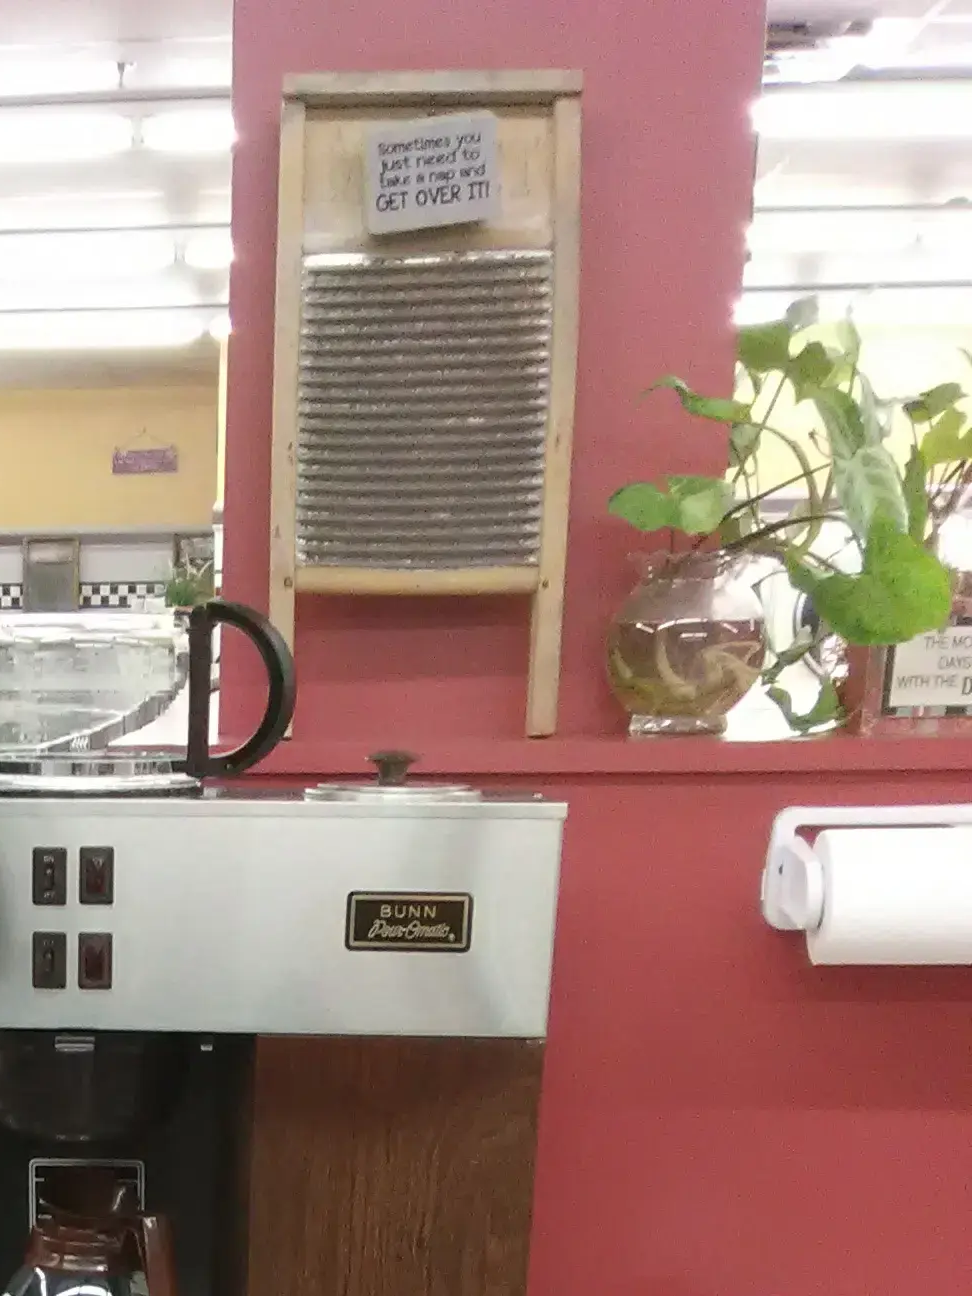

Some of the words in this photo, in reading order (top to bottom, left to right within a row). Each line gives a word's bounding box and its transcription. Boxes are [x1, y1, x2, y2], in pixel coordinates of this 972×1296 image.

[456, 132, 482, 152] you
[416, 150, 457, 168] need
[462, 148, 480, 161] to
[428, 169, 455, 185] nap
[375, 191, 408, 213] GET
[415, 184, 461, 206] OVER
[924, 635, 949, 651] THE
[896, 675, 929, 690] WITH
[935, 674, 959, 688] THE
[380, 904, 437, 918] BUNN
